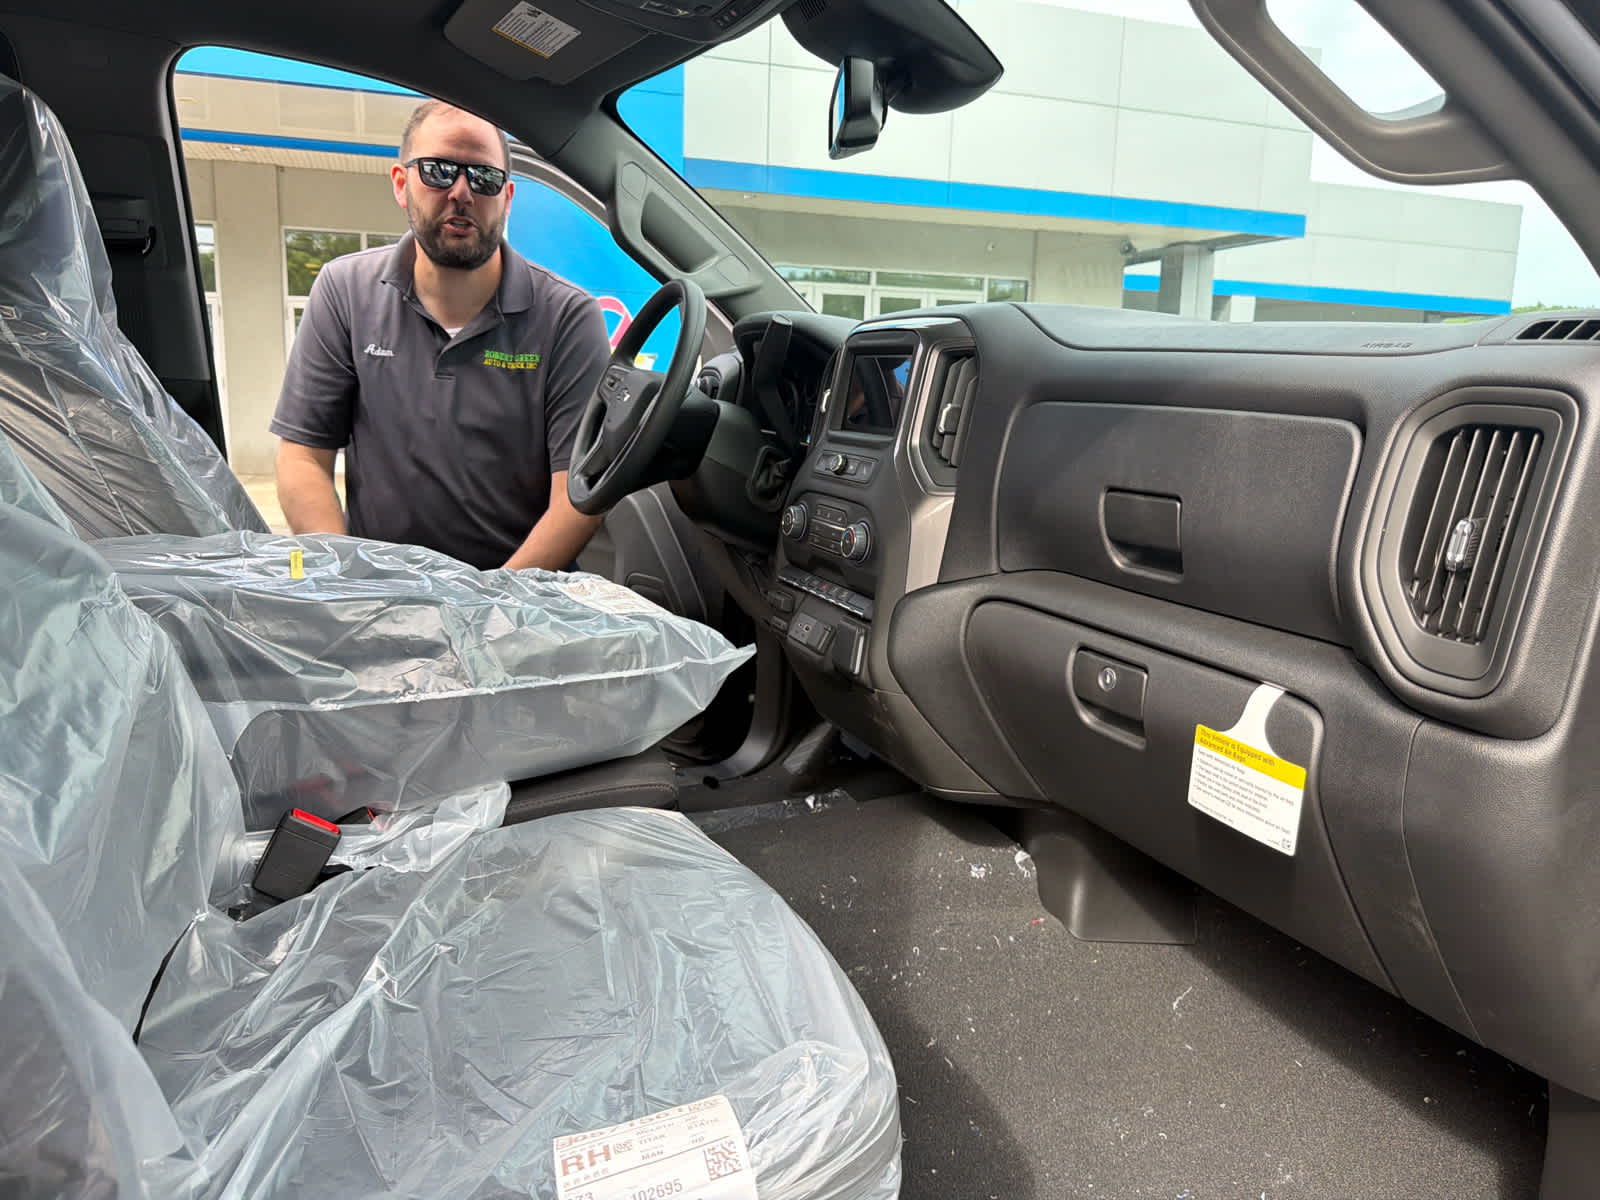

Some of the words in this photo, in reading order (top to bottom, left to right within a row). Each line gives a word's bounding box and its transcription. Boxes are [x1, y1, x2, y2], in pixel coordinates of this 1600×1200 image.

[364, 343, 394, 357] Adam
[483, 358, 501, 368] AUTO
[561, 1144, 611, 1177] RH
